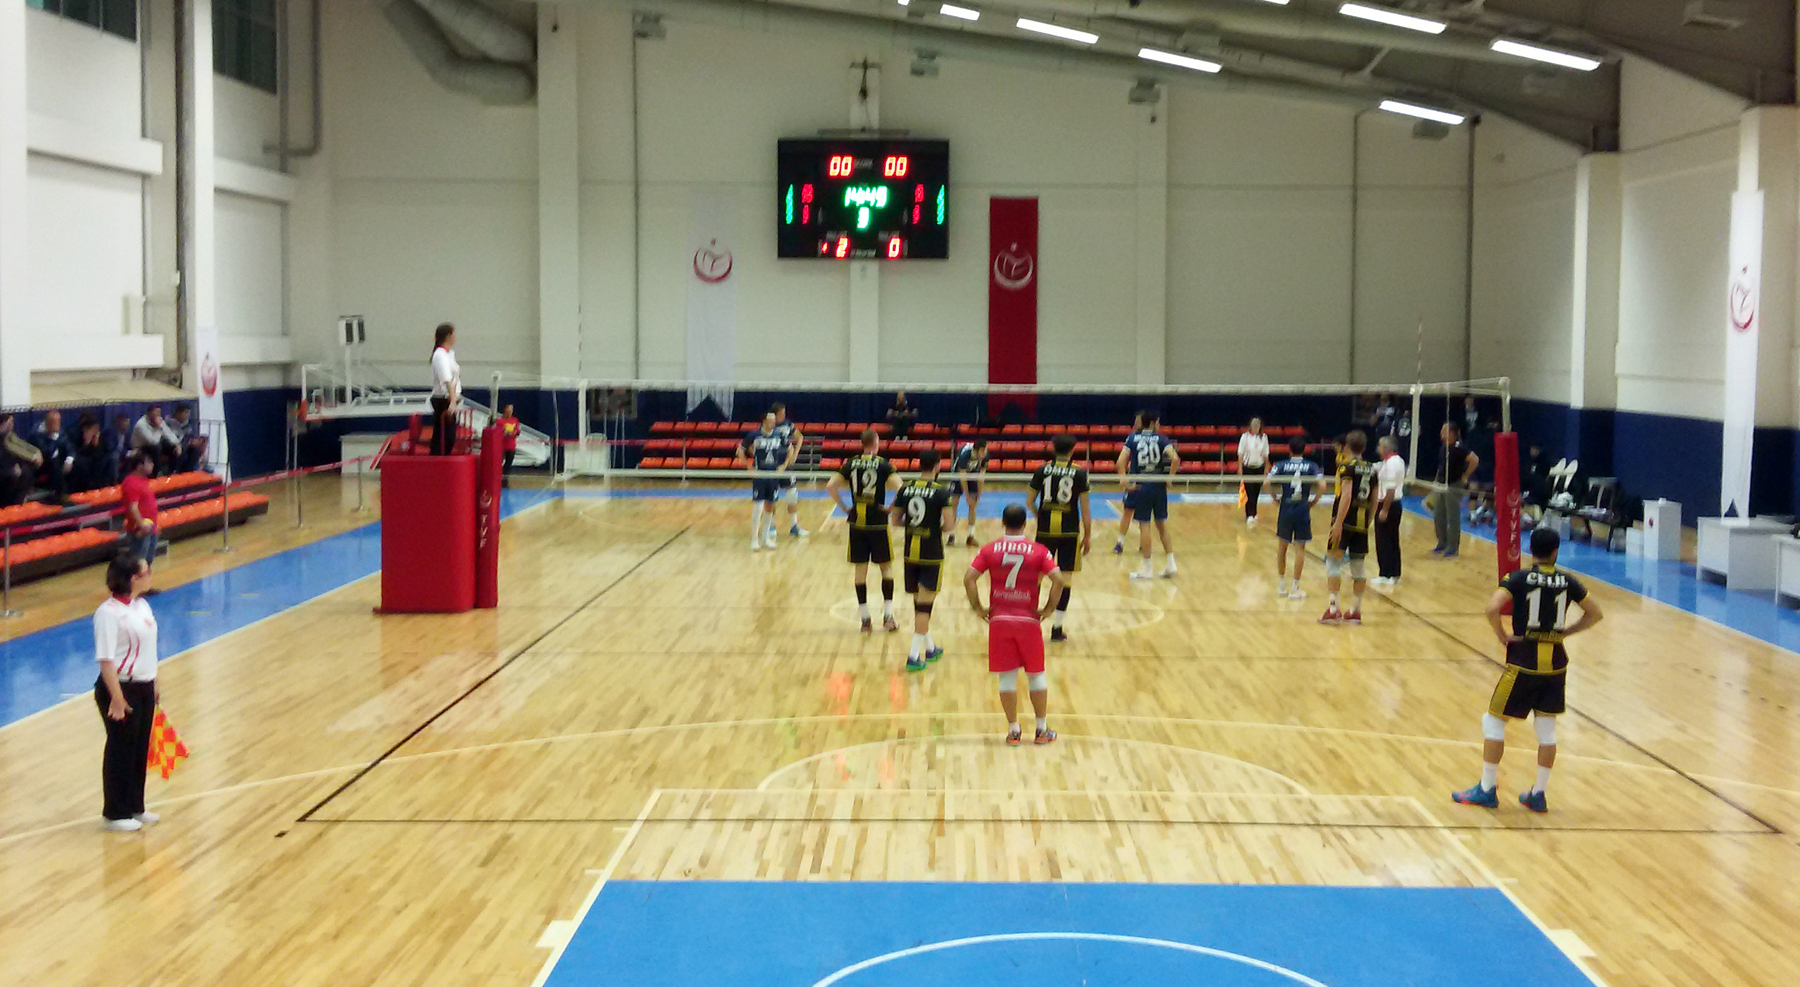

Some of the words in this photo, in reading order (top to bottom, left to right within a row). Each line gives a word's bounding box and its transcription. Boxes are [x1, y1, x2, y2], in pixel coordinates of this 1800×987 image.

[829, 155, 853, 177] 00
[884, 156, 908, 177] 00
[835, 237, 849, 258] 2
[888, 237, 901, 258] 0
[1137, 441, 1161, 466] 20
[851, 468, 878, 496] 12
[1042, 474, 1074, 504] 18
[907, 496, 926, 528] 9
[1509, 508, 1518, 543] TVF
[1001, 552, 1025, 590] 7
[1526, 587, 1568, 630] 11
